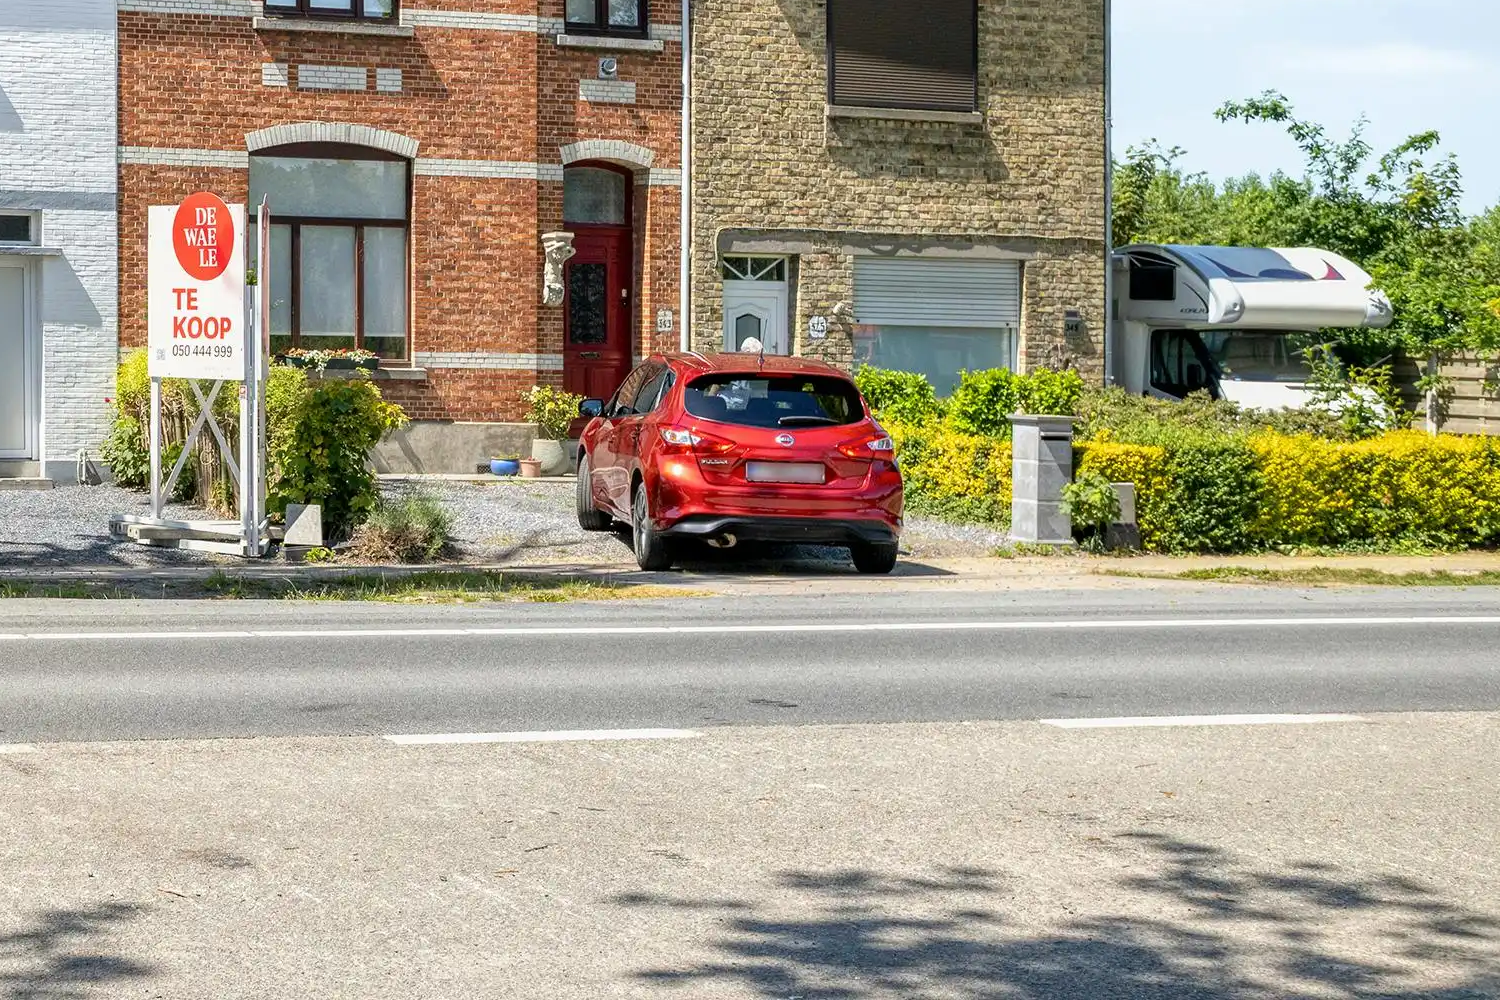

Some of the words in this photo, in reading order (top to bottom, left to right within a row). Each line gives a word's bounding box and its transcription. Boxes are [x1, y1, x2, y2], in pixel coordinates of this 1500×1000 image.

[195, 207, 217, 226] DE
[183, 228, 217, 246] WAE
[199, 248, 218, 267] LE
[172, 288, 198, 310] TE
[173, 316, 232, 339] KOOP
[172, 344, 190, 357] 050
[193, 345, 211, 357] 444
[214, 345, 232, 358] 999
